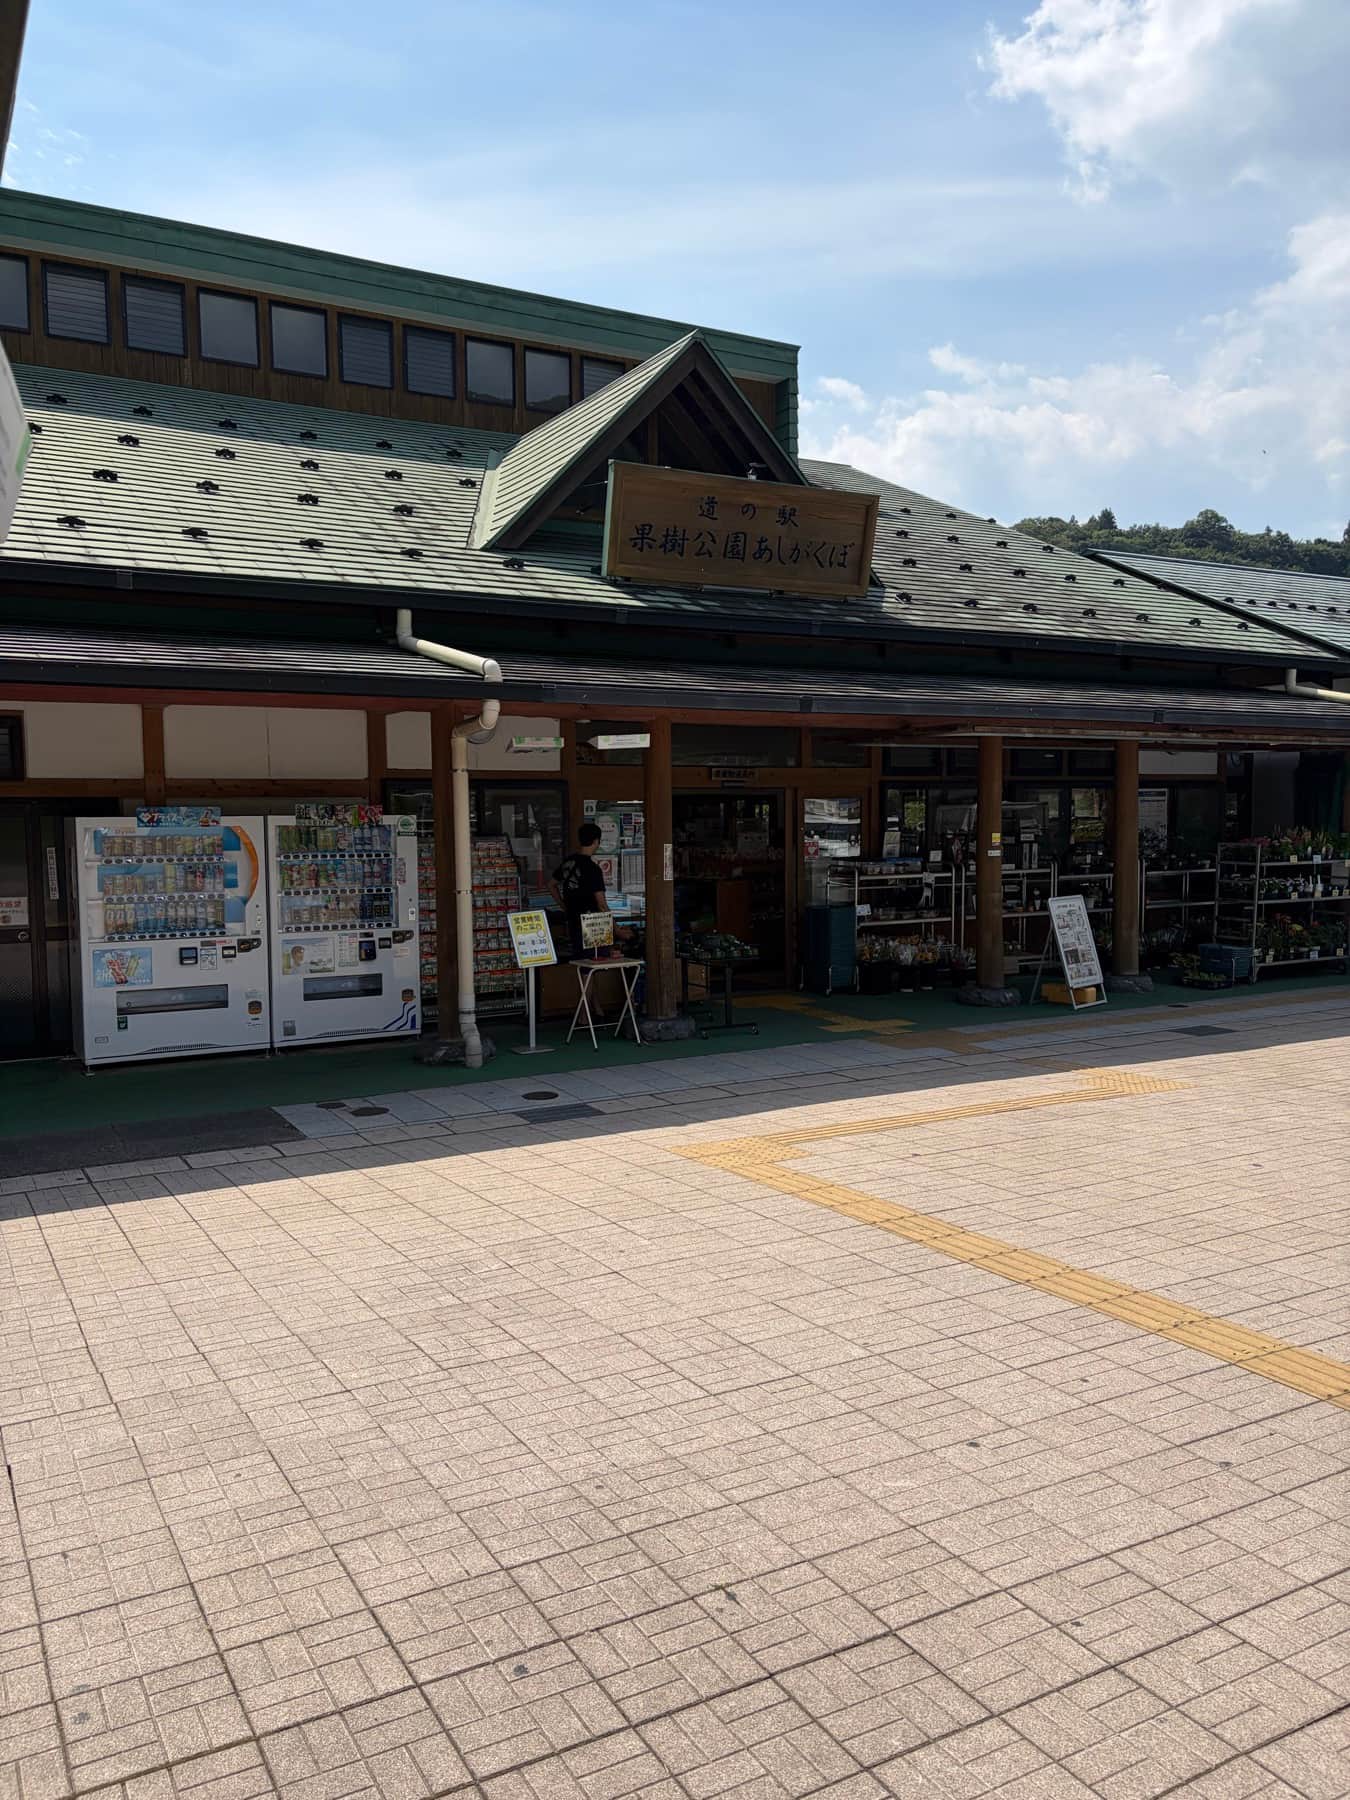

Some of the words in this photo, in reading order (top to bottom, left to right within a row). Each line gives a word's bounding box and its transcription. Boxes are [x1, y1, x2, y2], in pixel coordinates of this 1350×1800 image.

[698, 495, 799, 528] 道の駅
[629, 524, 855, 569] 果樹公園あしがくぼ
